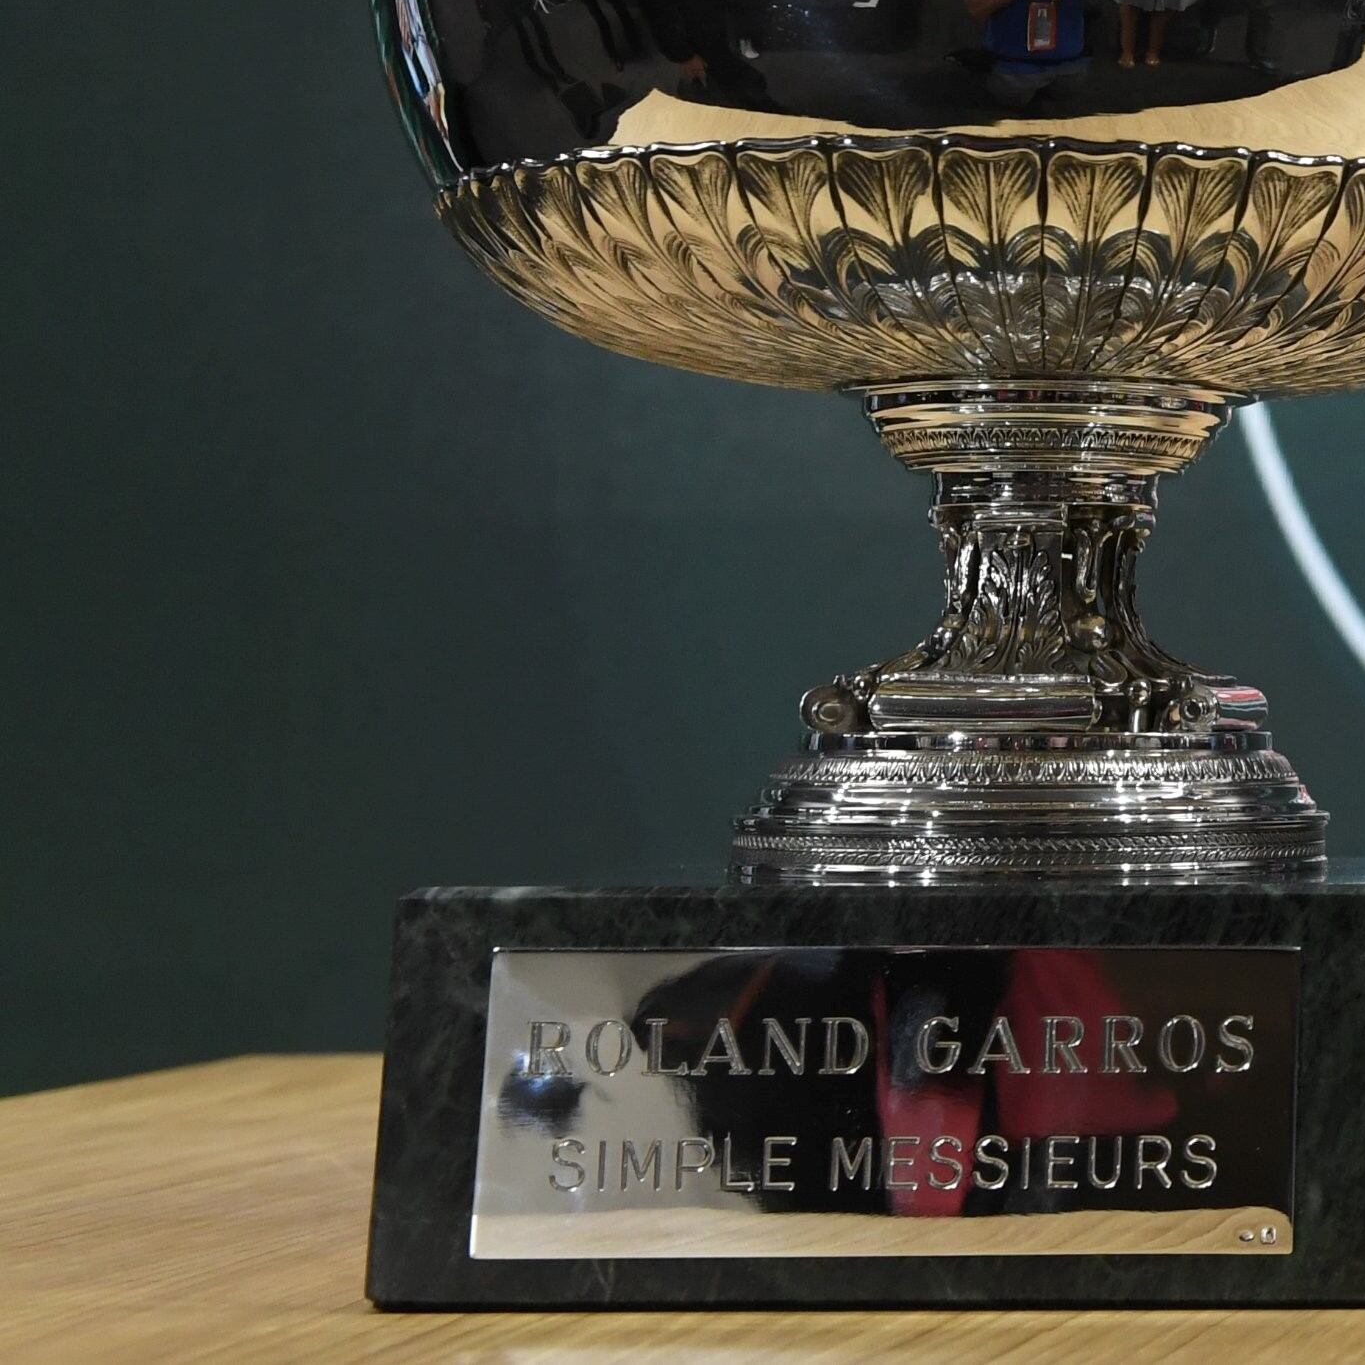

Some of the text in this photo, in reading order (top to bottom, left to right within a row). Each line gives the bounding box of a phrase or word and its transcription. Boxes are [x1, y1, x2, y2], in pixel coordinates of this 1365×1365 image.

[522, 1012, 1257, 1078] ROLAND GARROS
[548, 1133, 1220, 1193] SIMPLE MESSIEURS
